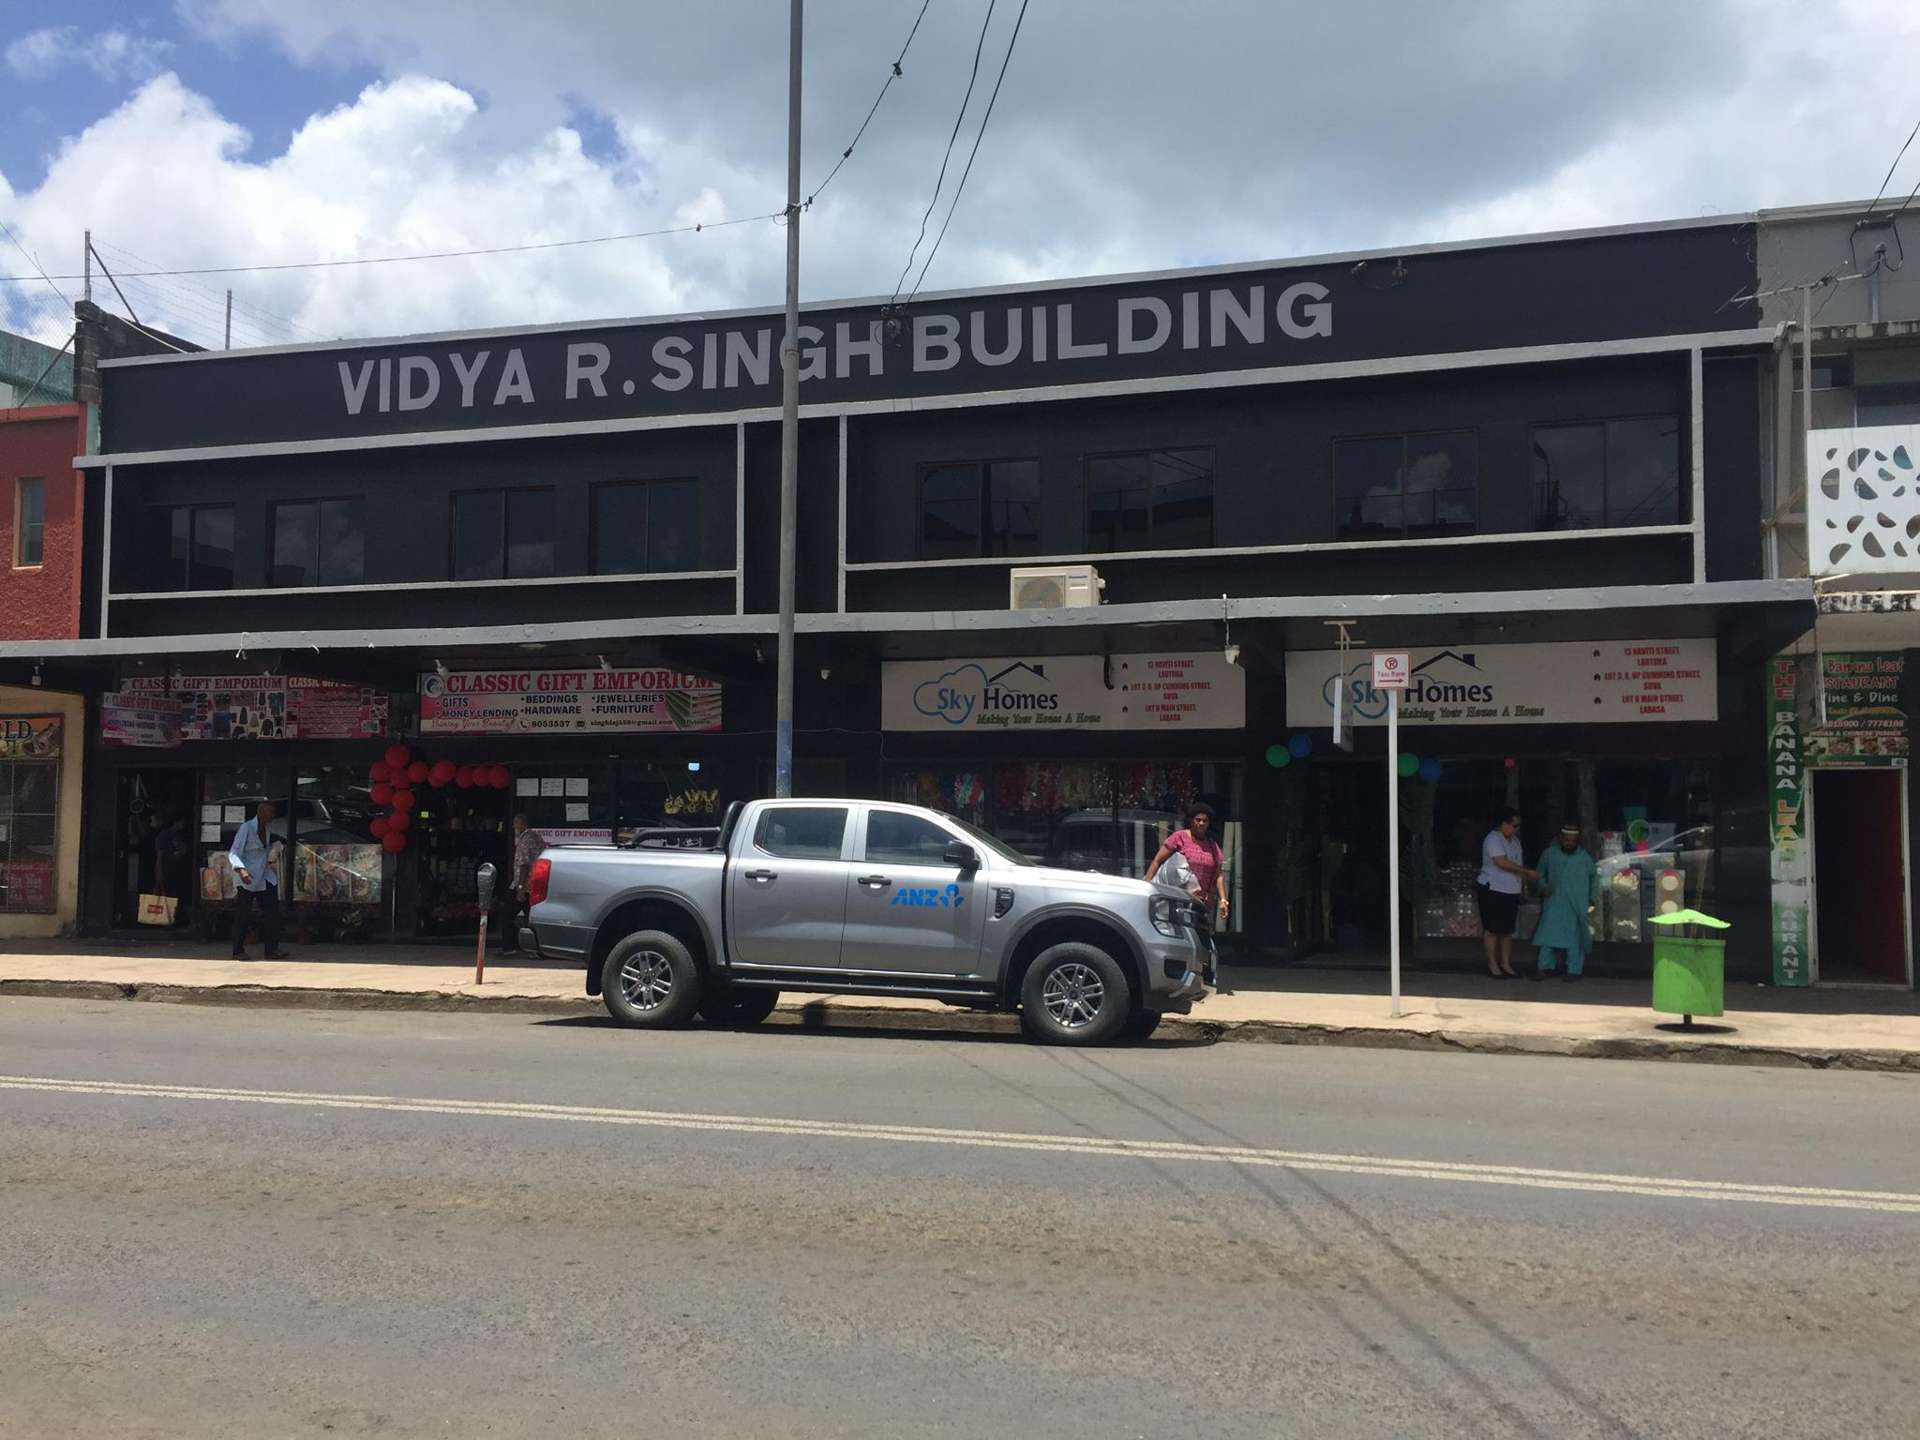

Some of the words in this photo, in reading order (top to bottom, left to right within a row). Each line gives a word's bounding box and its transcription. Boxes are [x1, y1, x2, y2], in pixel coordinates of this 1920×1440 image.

[337, 348, 535, 415] VIDYA
[912, 282, 1334, 372] BUILDING
[182, 677, 210, 689] GIFT
[214, 676, 283, 689] EMPORIUM
[447, 672, 531, 692] CLASSIC
[537, 671, 587, 691] GIFT
[592, 671, 715, 690] EMPORIUM
[1775, 660, 1796, 699] THE
[442, 697, 469, 708] GIFTS
[525, 693, 579, 704] BEDDINGS
[595, 693, 665, 703] JEWELLERIES
[937, 687, 977, 715] Sky
[983, 688, 1059, 710] Homes
[1351, 680, 1379, 703] Sk
[1405, 679, 1493, 703] Homes
[1853, 693, 1865, 703] &
[1869, 692, 1899, 703] Dine
[442, 708, 474, 718] MONEY
[477, 708, 519, 718] LENDING
[525, 705, 582, 715] HARDWARE
[595, 704, 655, 714] FURNITURE
[976, 714, 1010, 727] Making
[1065, 713, 1073, 723] A
[1440, 707, 1463, 718] Your
[1502, 706, 1510, 717] A
[1775, 711, 1797, 789] BANANA
[890, 887, 938, 907] ANZ
